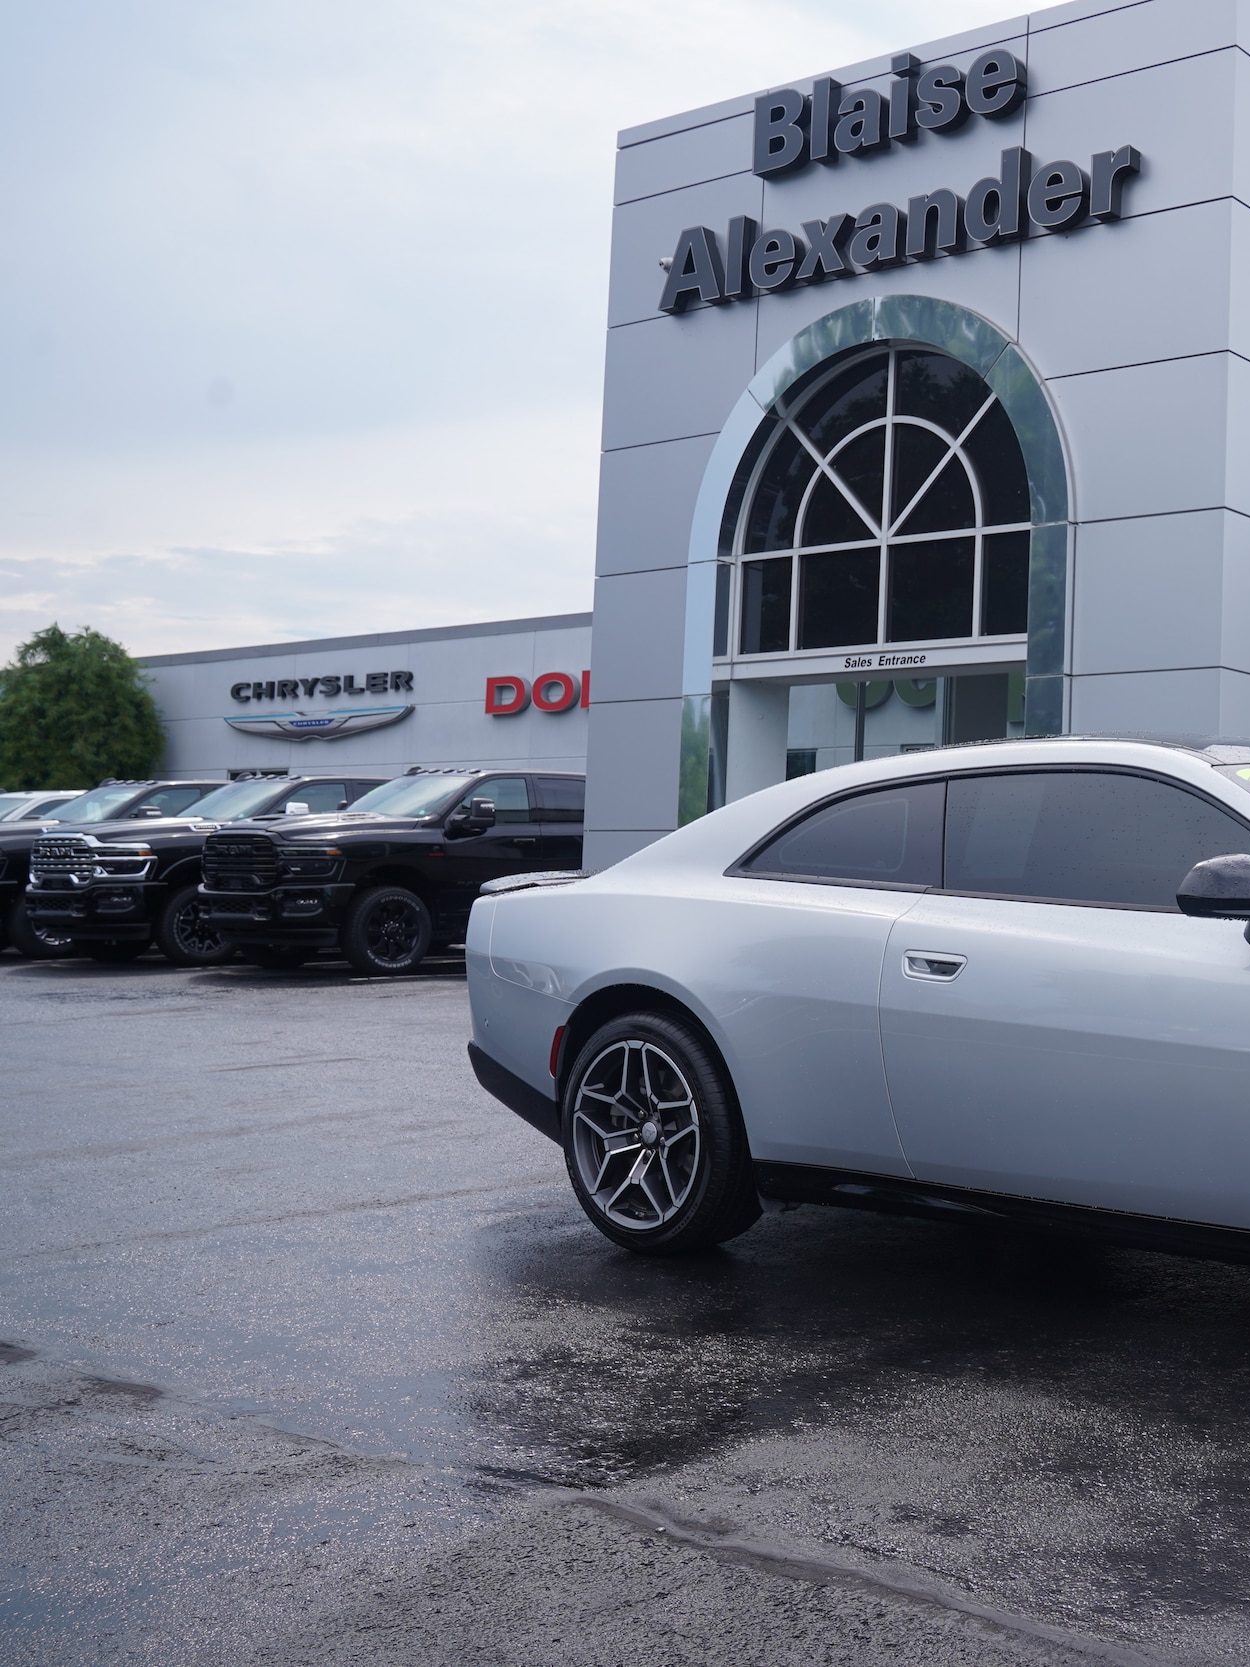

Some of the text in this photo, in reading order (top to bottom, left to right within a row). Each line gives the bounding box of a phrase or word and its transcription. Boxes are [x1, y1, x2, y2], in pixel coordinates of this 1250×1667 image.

[752, 48, 1027, 179] Blaise
[658, 144, 1141, 313] Alexander
[230, 671, 414, 703] CHRYSLER
[844, 654, 927, 669] Sales Entrance
